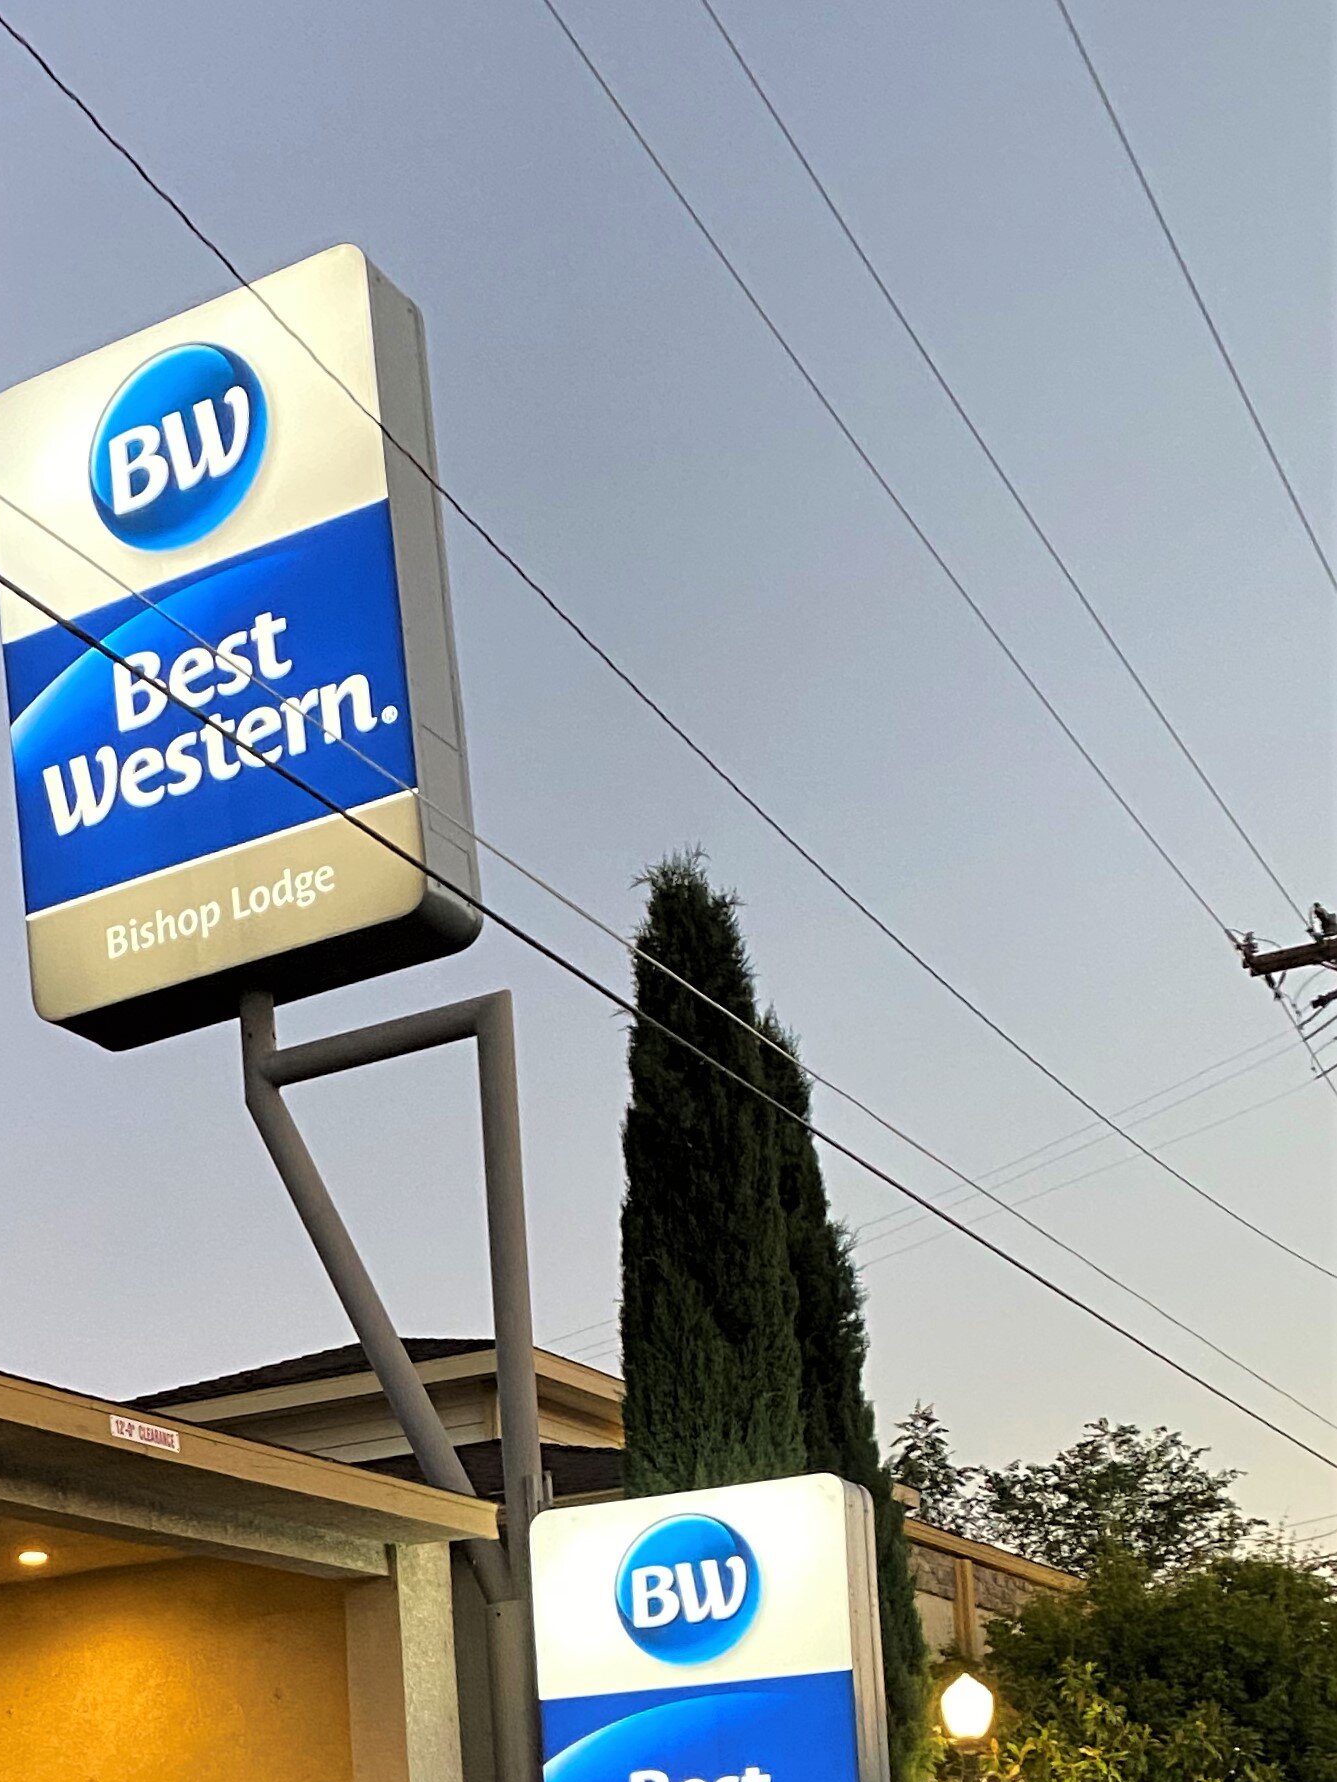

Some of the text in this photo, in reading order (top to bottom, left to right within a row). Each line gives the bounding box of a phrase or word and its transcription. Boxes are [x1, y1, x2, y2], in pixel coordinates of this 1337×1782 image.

[107, 384, 251, 517] BW
[112, 611, 294, 734] Best
[105, 865, 336, 960] Bishop Lodge
[631, 1555, 747, 1629] BW
